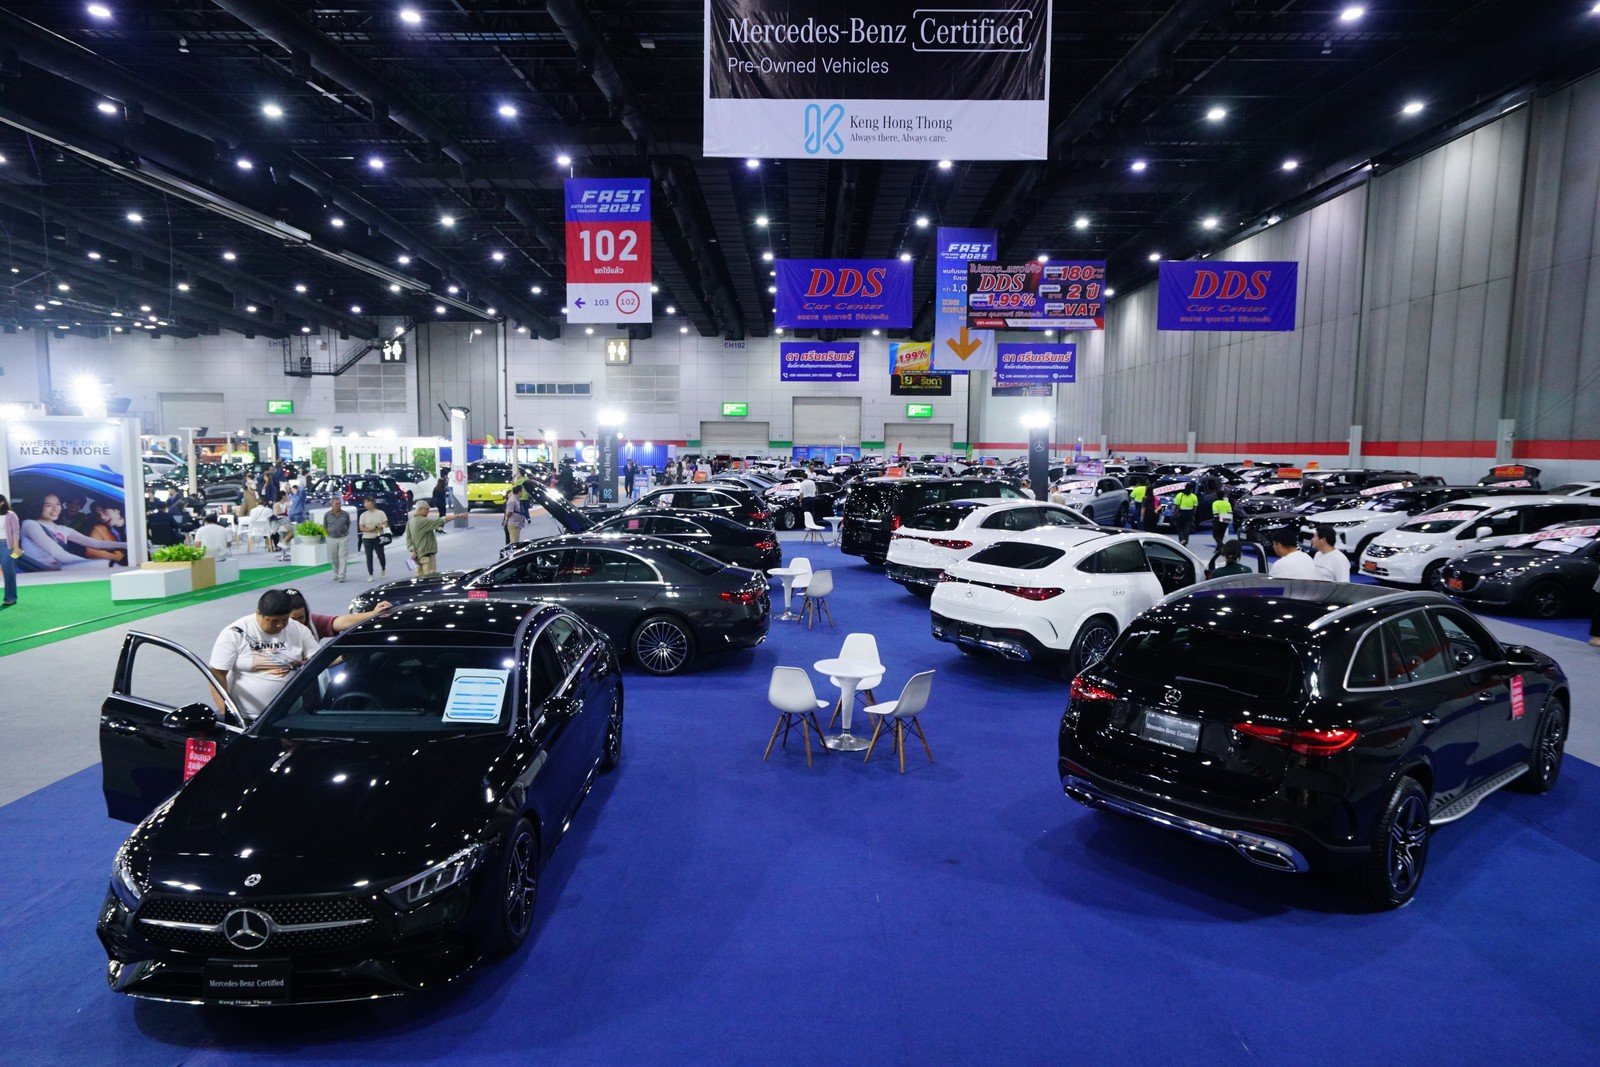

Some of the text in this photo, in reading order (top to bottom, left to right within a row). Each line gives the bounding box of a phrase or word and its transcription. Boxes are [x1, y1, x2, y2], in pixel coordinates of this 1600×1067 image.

[727, 17, 1025, 45] Mercedes-Benz Certified
[728, 57, 889, 74] Pre-Owned Vehicles
[850, 116, 953, 131] Keng Hong Thong
[850, 134, 877, 144] Always
[901, 134, 927, 144] Always
[928, 135, 947, 143] care.
[581, 189, 645, 203] FAST
[598, 203, 642, 213] 2025
[579, 229, 638, 262] 102
[948, 243, 991, 253] FAST
[1060, 265, 1094, 281] 180
[803, 267, 887, 298] DDS
[976, 273, 1027, 292] DDS
[1187, 270, 1272, 300] DDS
[1066, 282, 1101, 300] 2 ปี
[594, 299, 609, 307] 103
[620, 298, 636, 306] 102
[987, 292, 1036, 307] 1.99%
[802, 302, 885, 310] Car Center
[1064, 303, 1101, 316] VAT
[1185, 304, 1214, 312] Car
[724, 341, 746, 349] EH102
[785, 350, 856, 362] ดา ศรีนครินทร์
[1002, 351, 1073, 363] ดา ศรีนครินทร์
[20, 439, 110, 447] WHERE THE DRIVE
[20, 446, 111, 456] MEANS MORE
[1145, 723, 1176, 735] Mercedes-Benz
[209, 979, 284, 988] Mercedes-Benz Certified
